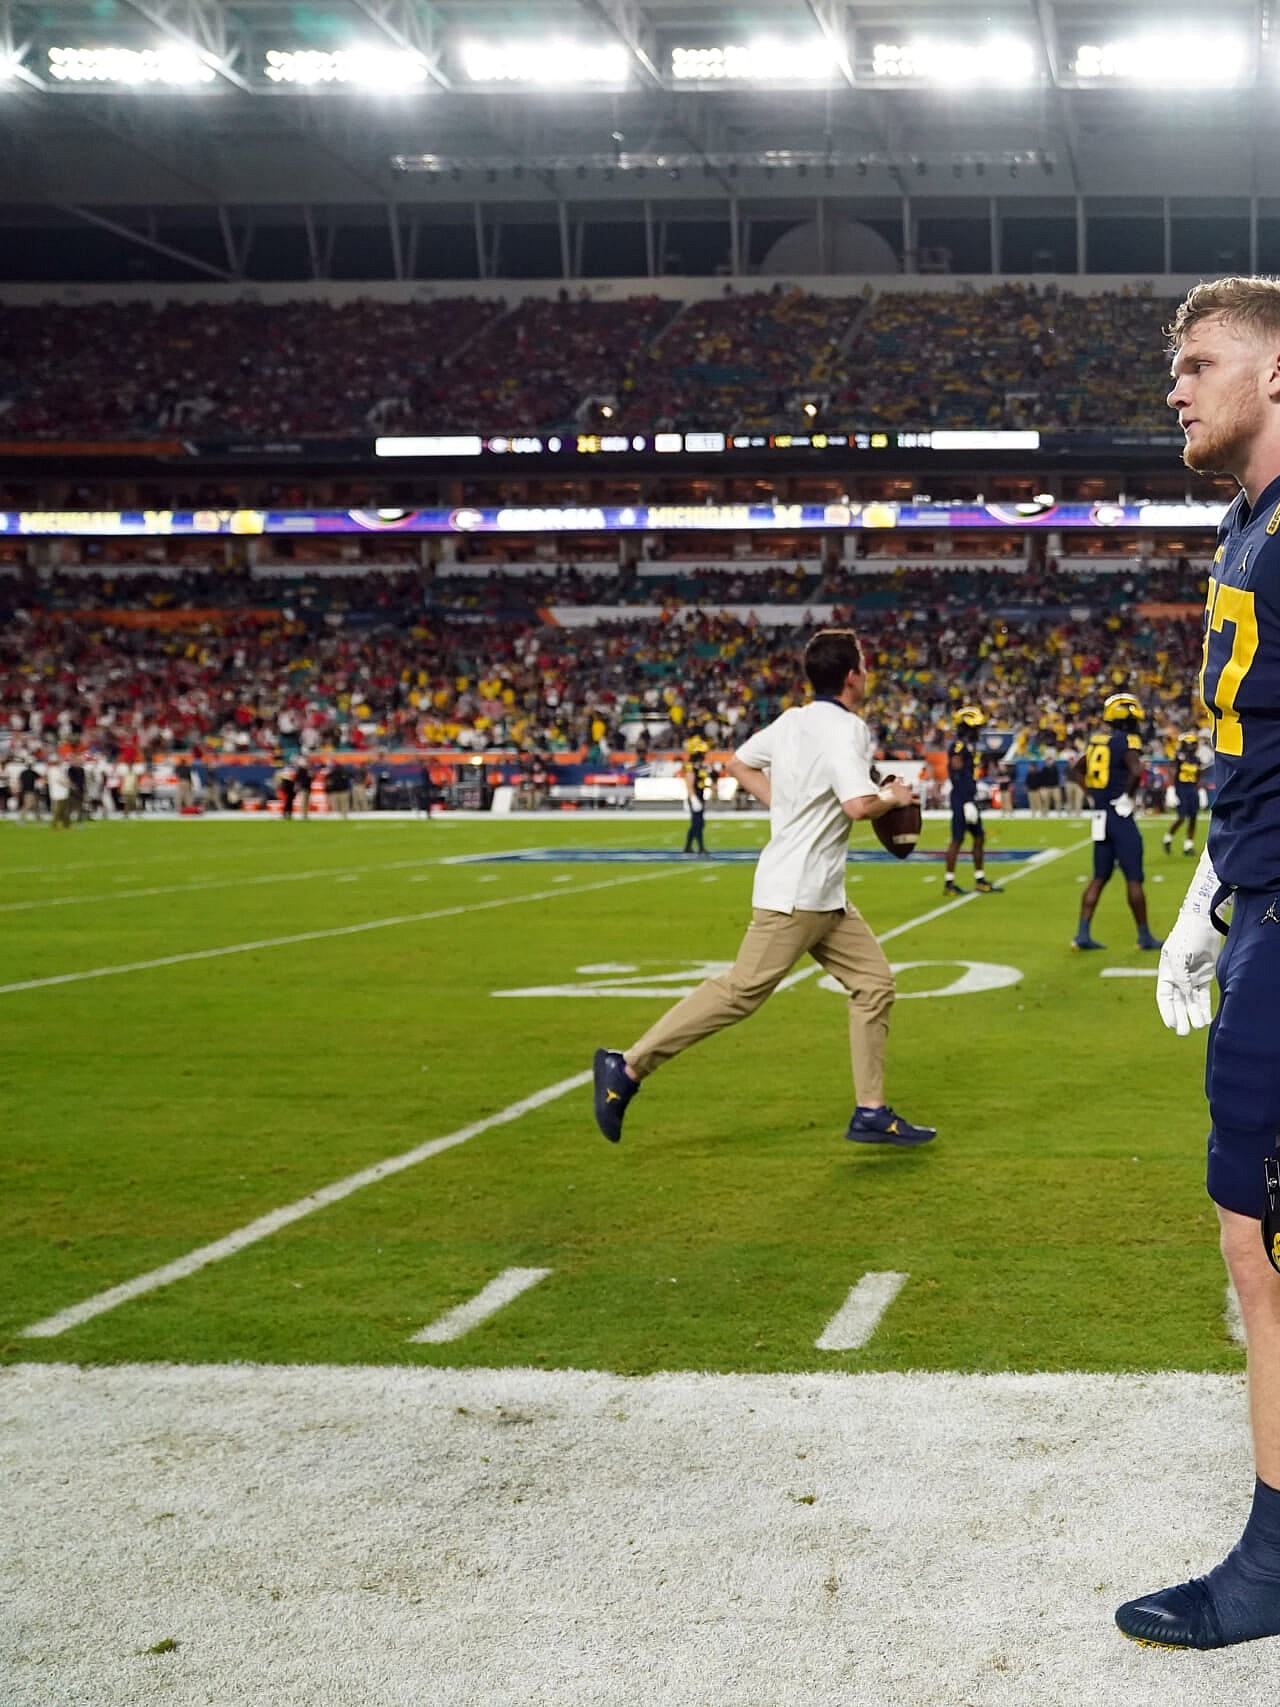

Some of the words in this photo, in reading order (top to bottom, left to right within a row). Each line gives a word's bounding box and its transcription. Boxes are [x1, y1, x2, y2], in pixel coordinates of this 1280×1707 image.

[497, 509, 605, 531] GEORGIA
[647, 506, 749, 529] MICHIGAN
[1199, 577, 1260, 757] 7
